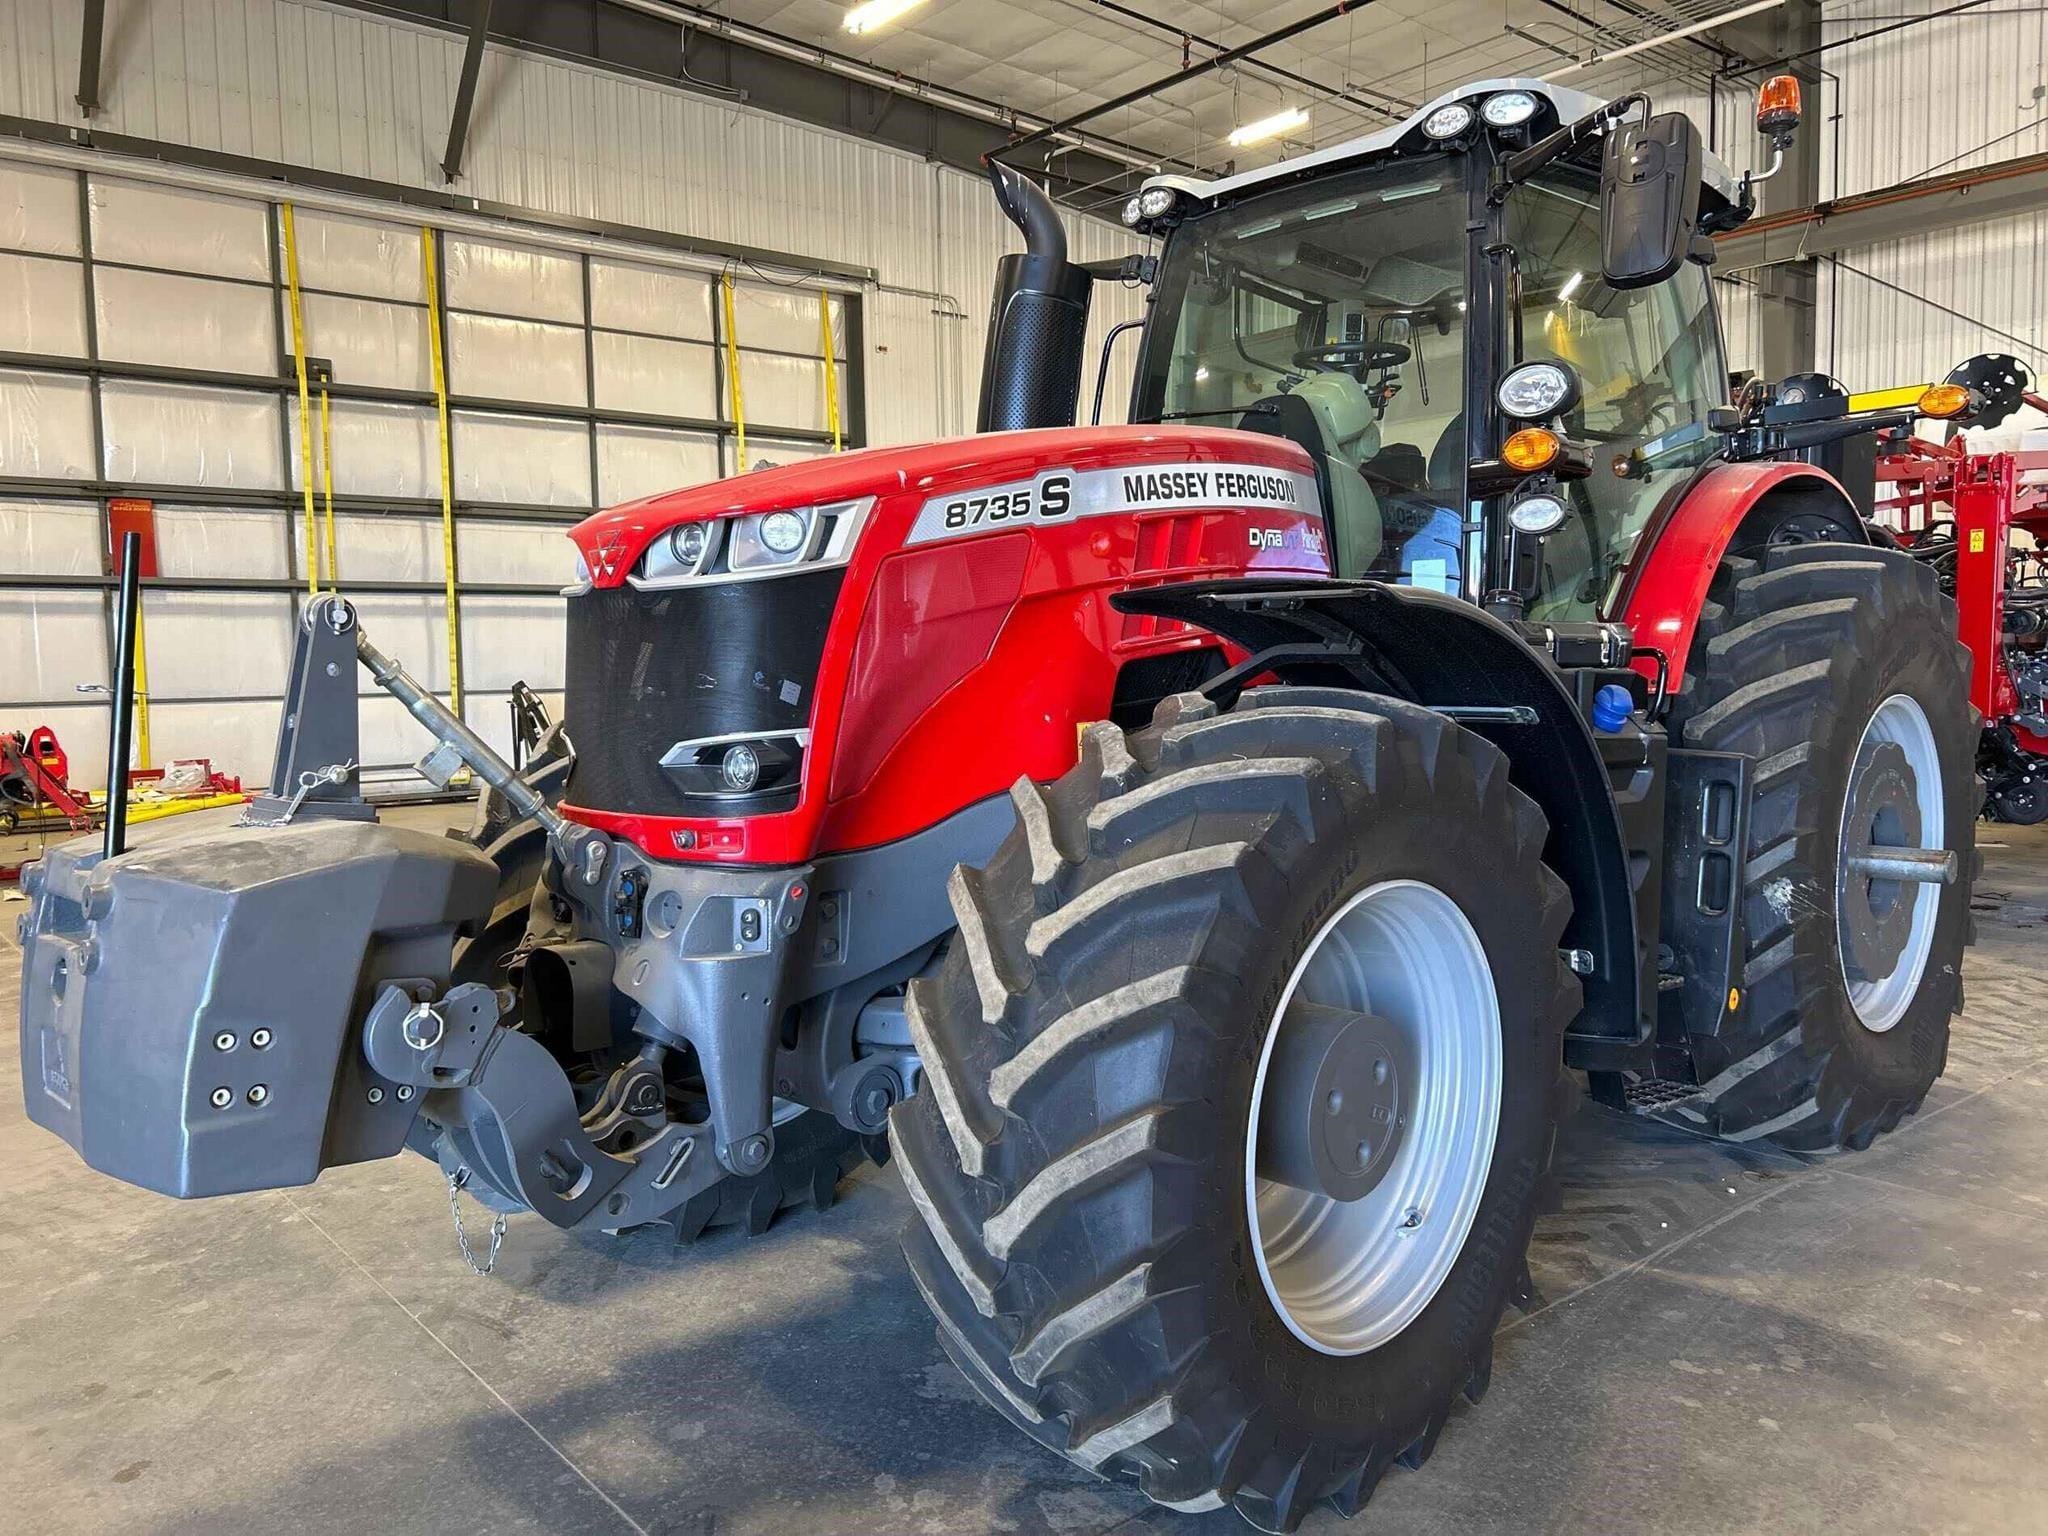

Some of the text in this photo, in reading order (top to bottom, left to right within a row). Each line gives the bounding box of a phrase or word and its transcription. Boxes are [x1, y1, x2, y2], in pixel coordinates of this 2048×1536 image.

[944, 476, 1072, 529] 8735 S
[1124, 472, 1296, 503] MASSEY FERGUSON
